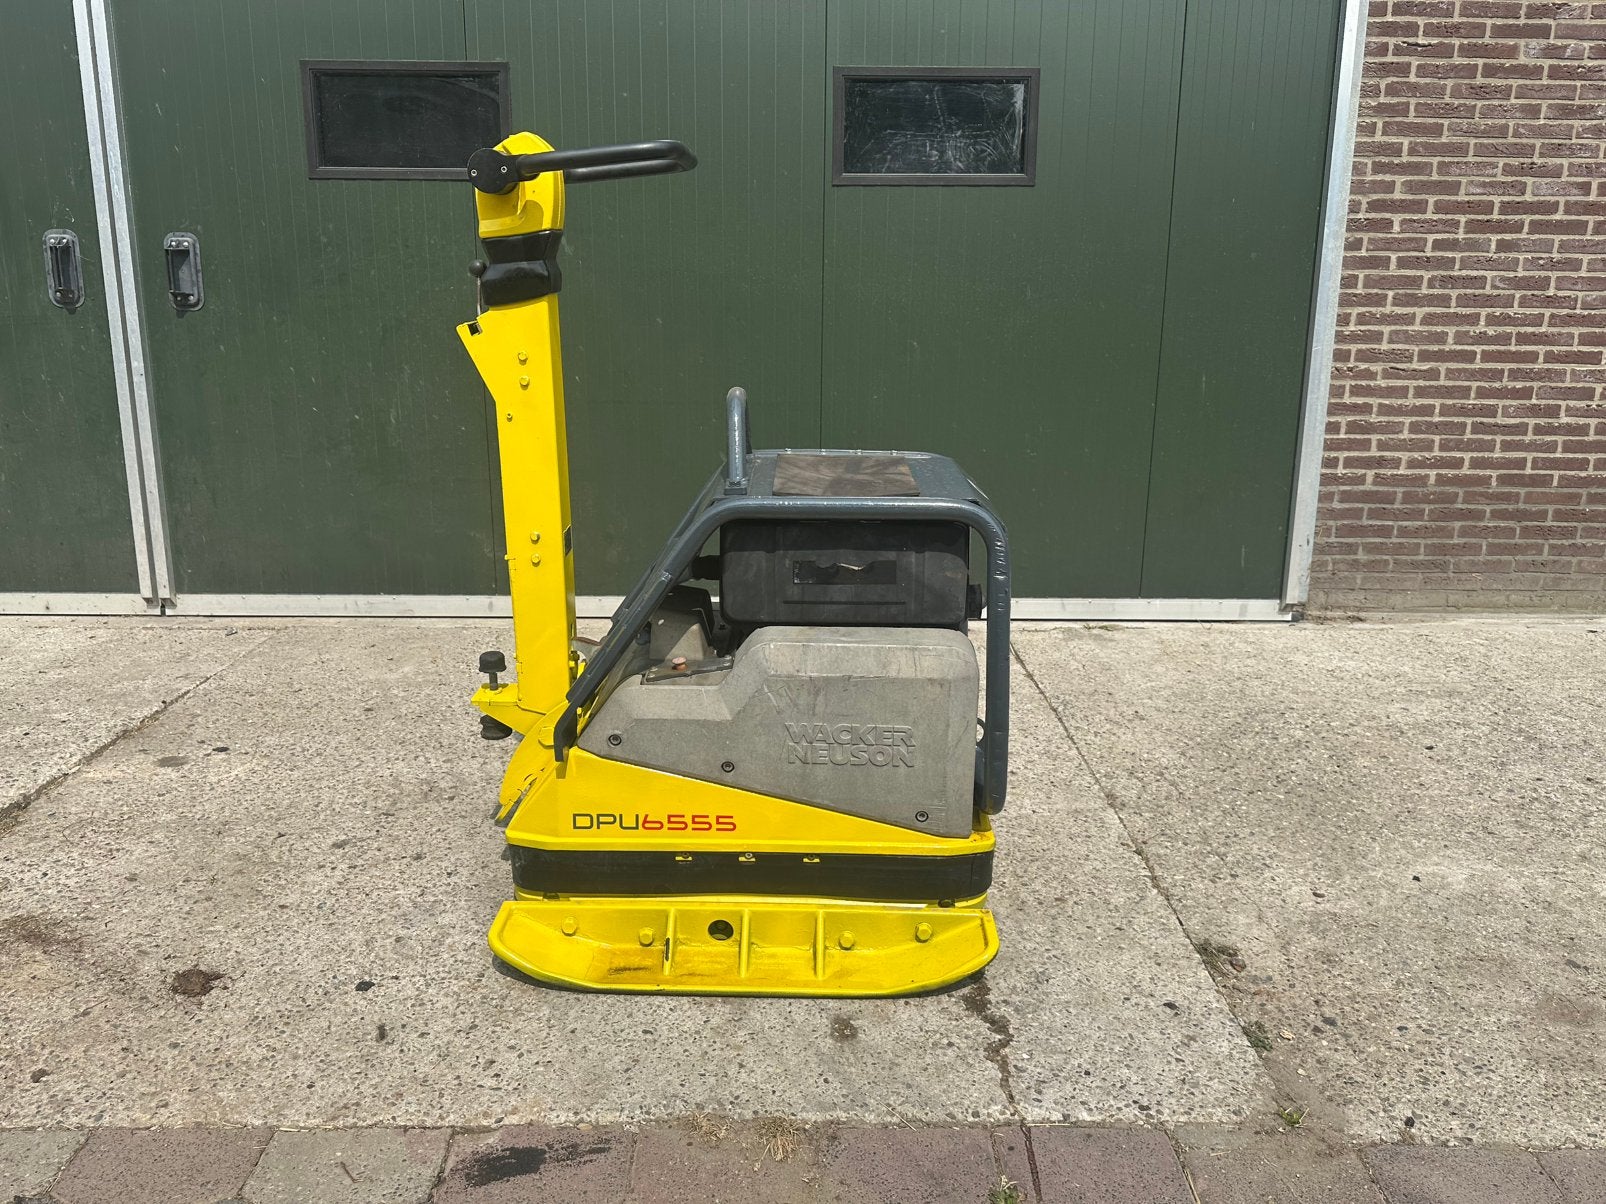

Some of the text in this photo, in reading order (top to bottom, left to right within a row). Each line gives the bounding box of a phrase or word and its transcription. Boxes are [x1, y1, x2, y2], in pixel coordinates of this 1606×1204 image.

[784, 722, 917, 748] WACKER
[787, 742, 915, 768] NEUSON
[572, 813, 737, 832] DPU6555
